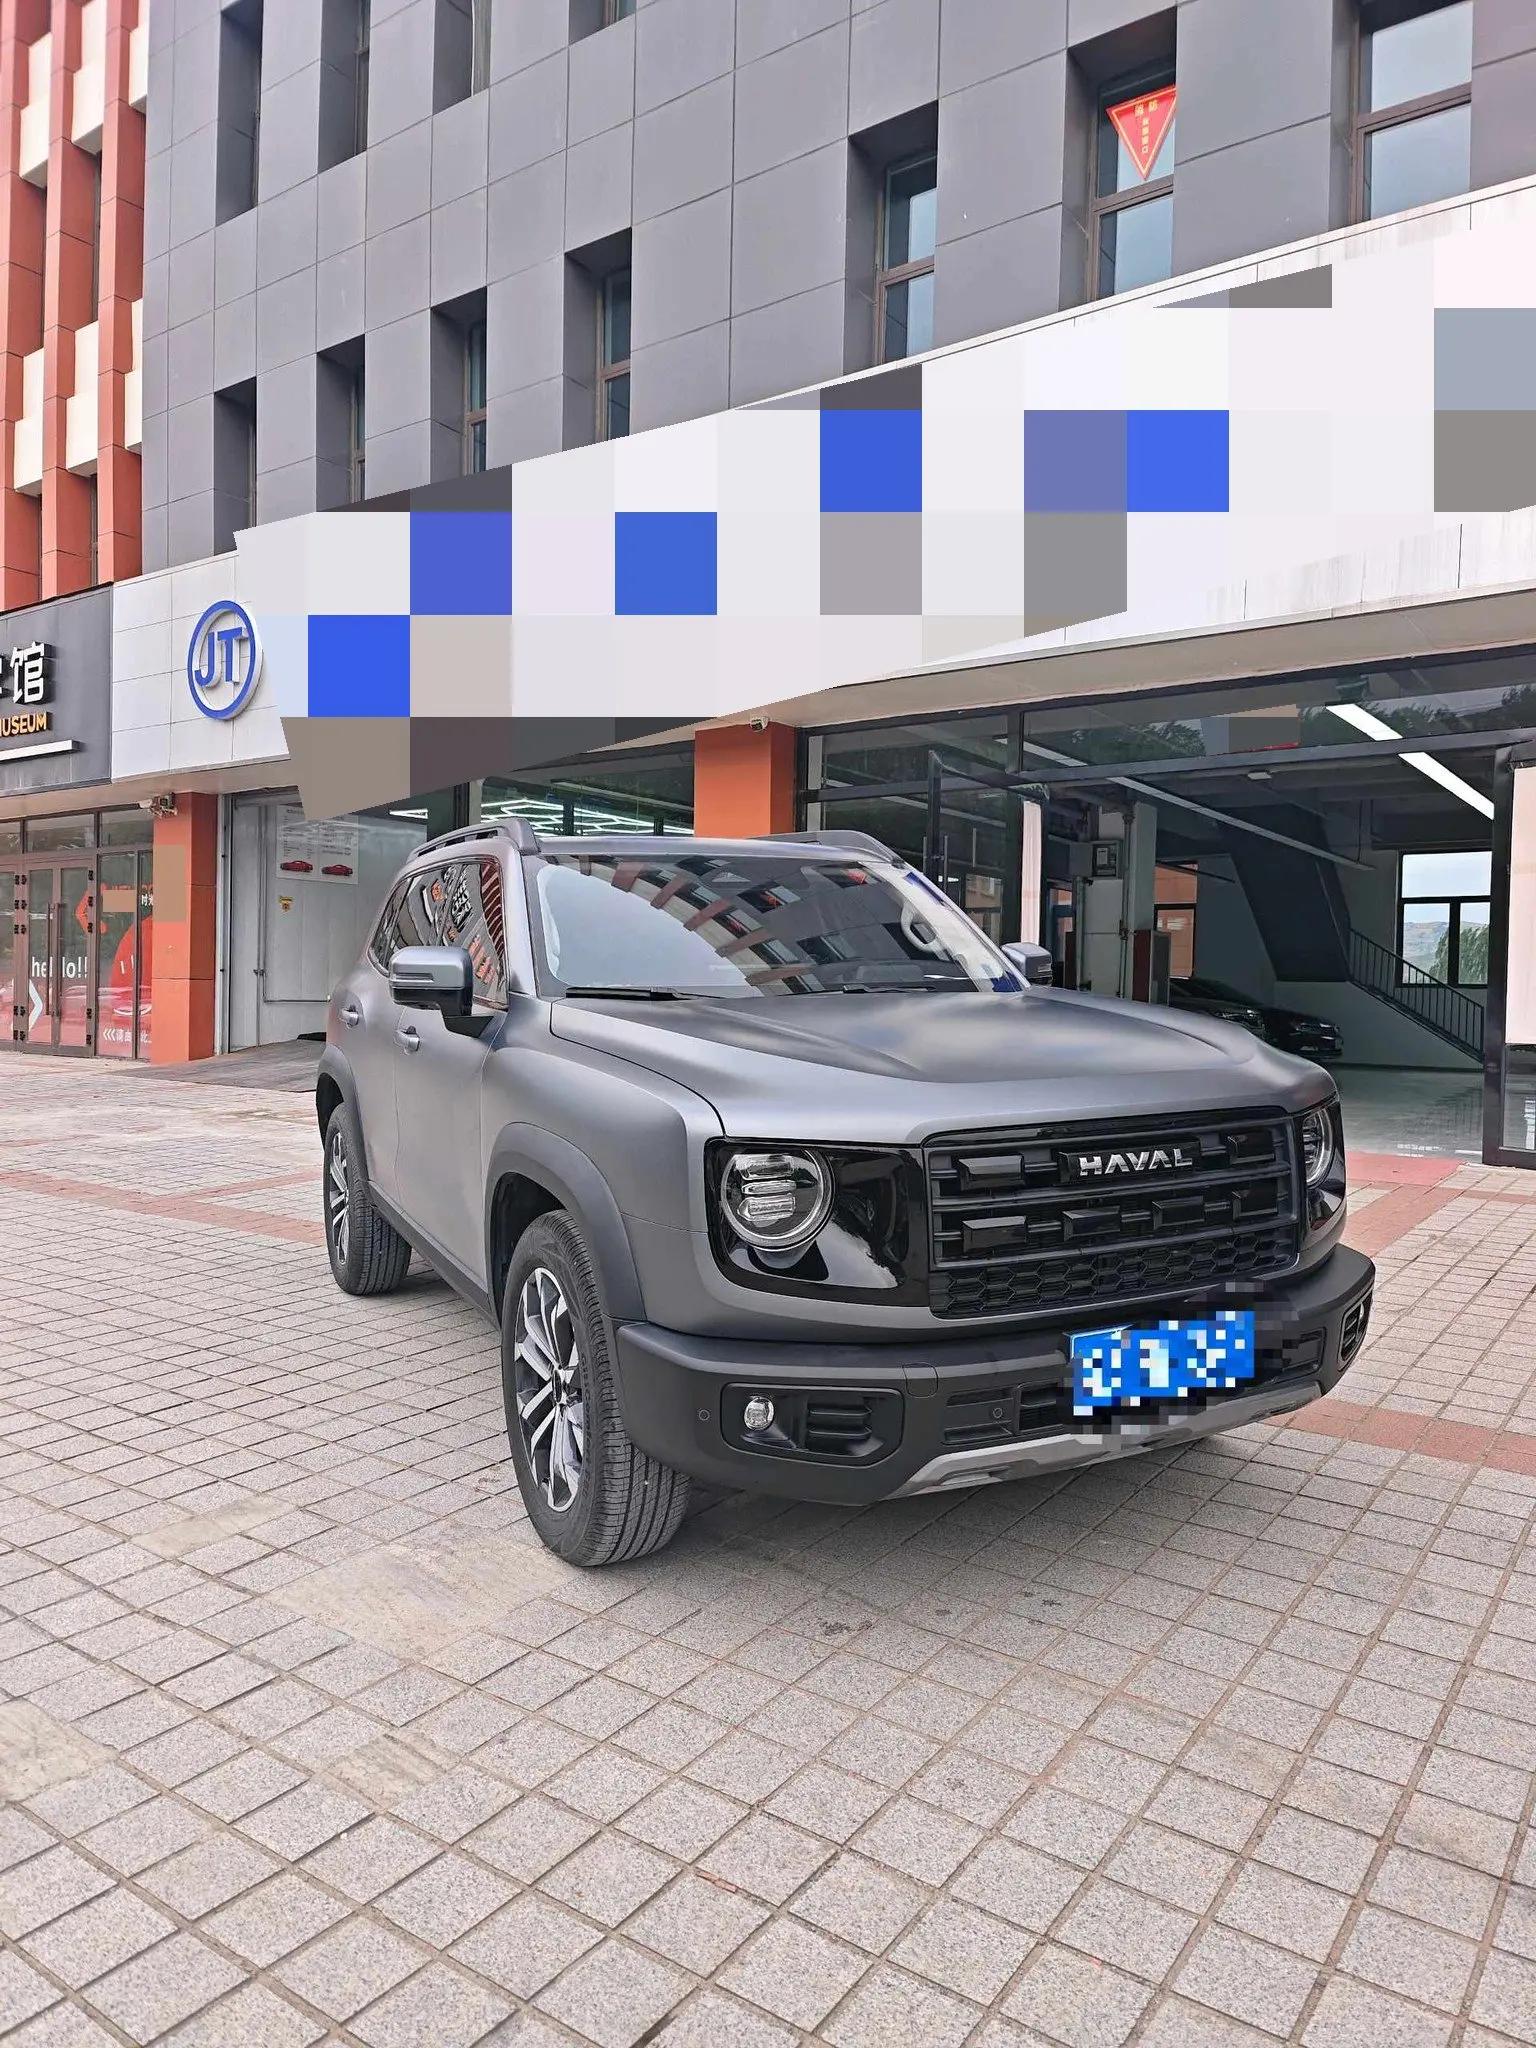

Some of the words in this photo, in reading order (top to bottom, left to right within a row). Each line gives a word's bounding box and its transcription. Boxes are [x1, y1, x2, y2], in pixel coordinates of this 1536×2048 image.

[0, 641, 45, 704] 馆
[194, 627, 245, 687] JT
[0, 711, 48, 738] USEUM
[1079, 1148, 1193, 1176] HAVAL
